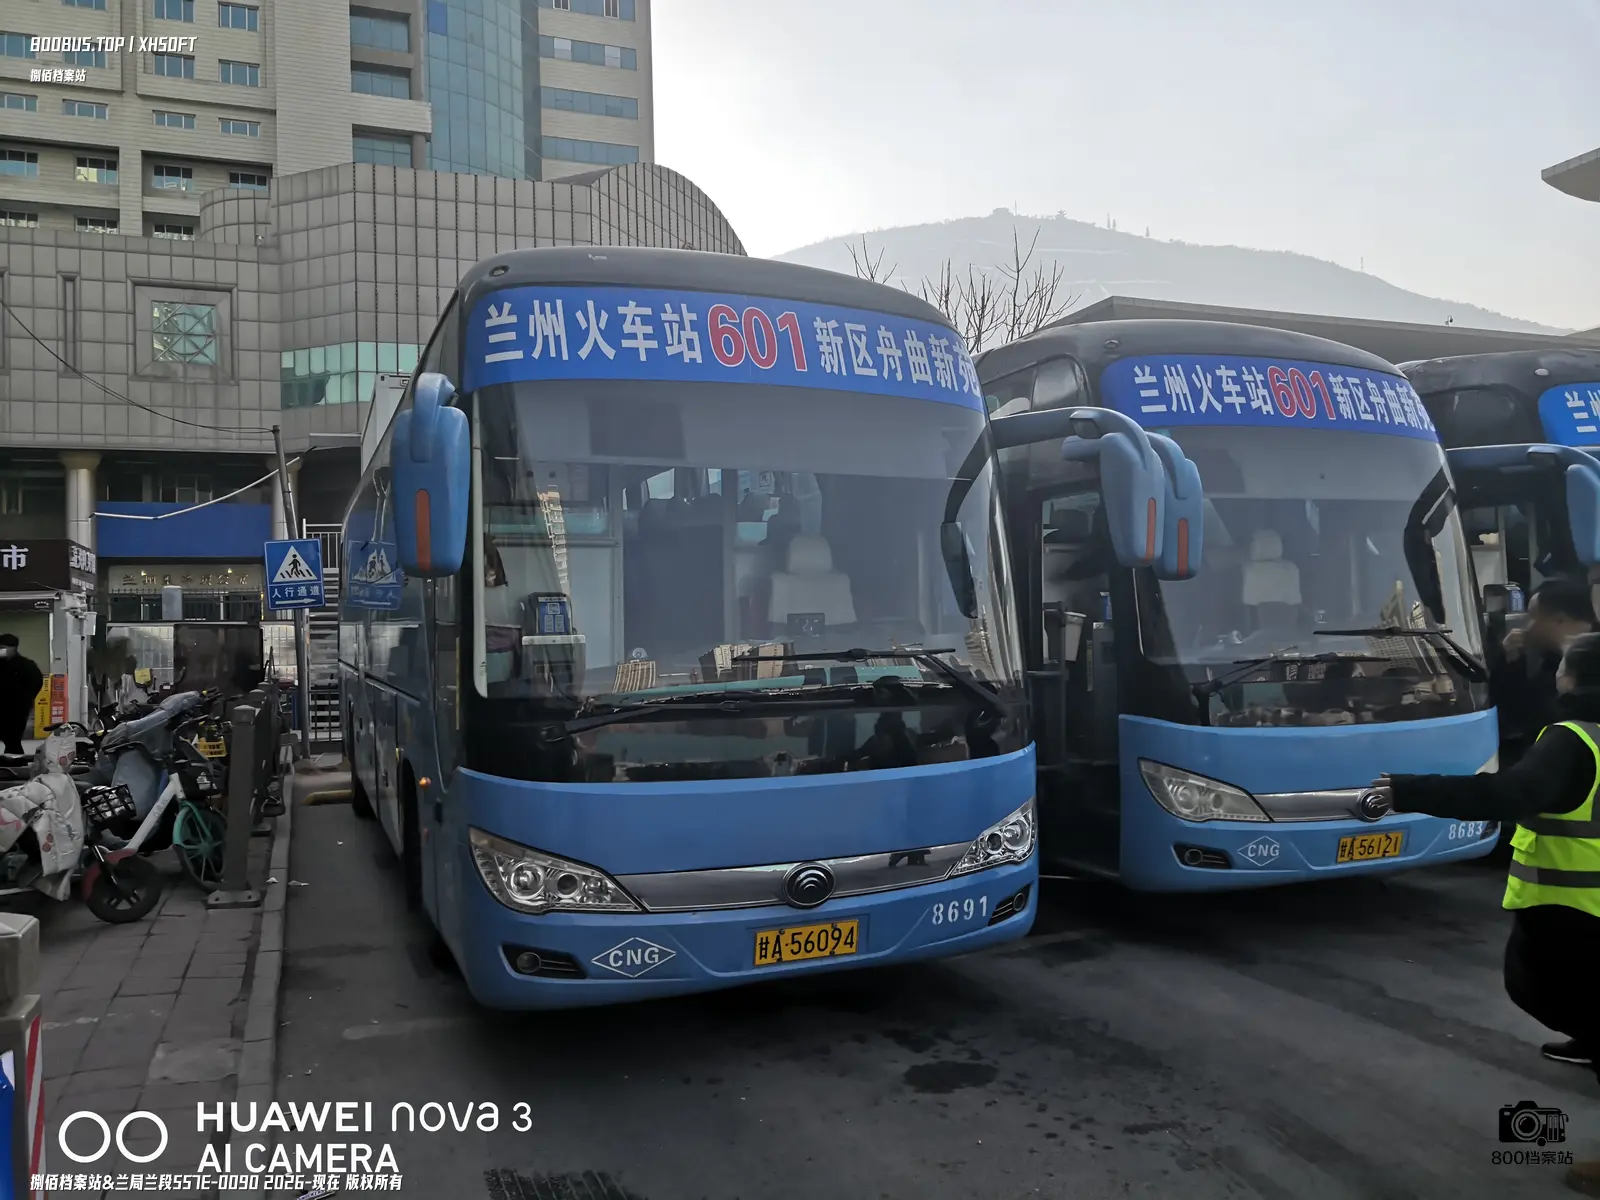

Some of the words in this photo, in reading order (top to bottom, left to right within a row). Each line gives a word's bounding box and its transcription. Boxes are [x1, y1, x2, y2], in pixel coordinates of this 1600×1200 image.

[484, 298, 704, 365] 兰州火车站
[706, 302, 809, 373] 601
[1133, 362, 1275, 416] 兰州火车站
[1267, 365, 1337, 421] 601
[271, 585, 320, 599] 人行通道
[1448, 821, 1484, 840] 8683
[1247, 843, 1280, 858] CNG
[931, 894, 989, 926] 8691
[608, 945, 661, 967] CNG
